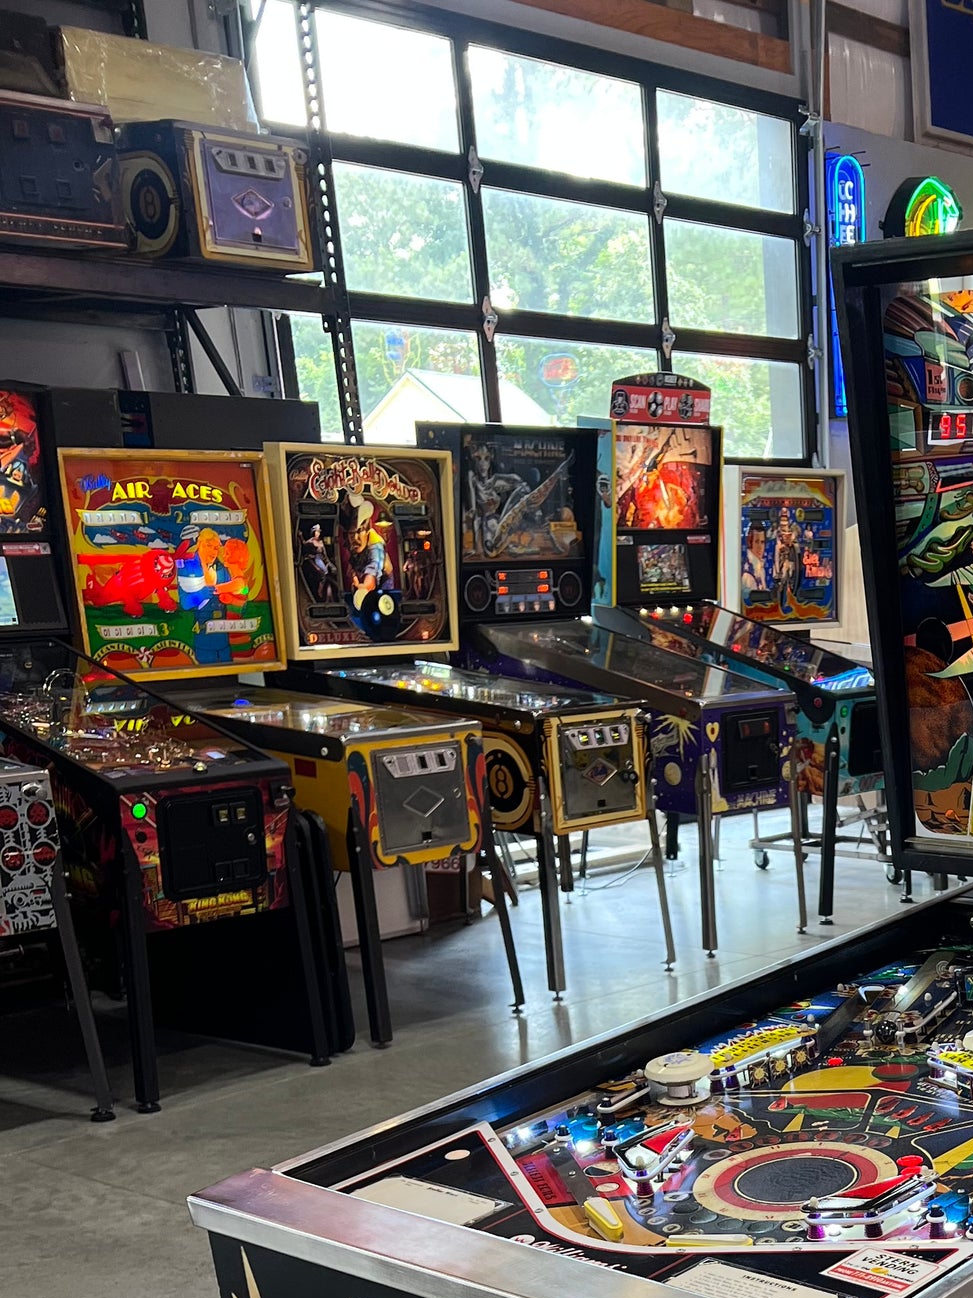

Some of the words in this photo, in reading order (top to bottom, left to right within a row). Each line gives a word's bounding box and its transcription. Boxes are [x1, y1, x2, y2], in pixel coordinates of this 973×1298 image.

[112, 481, 153, 501] AIR
[172, 482, 223, 503] ACES
[861, 1256, 920, 1276] VENDING
[875, 1254, 920, 1269] STERN
[742, 1273, 798, 1292] INSTRUCTIONS
